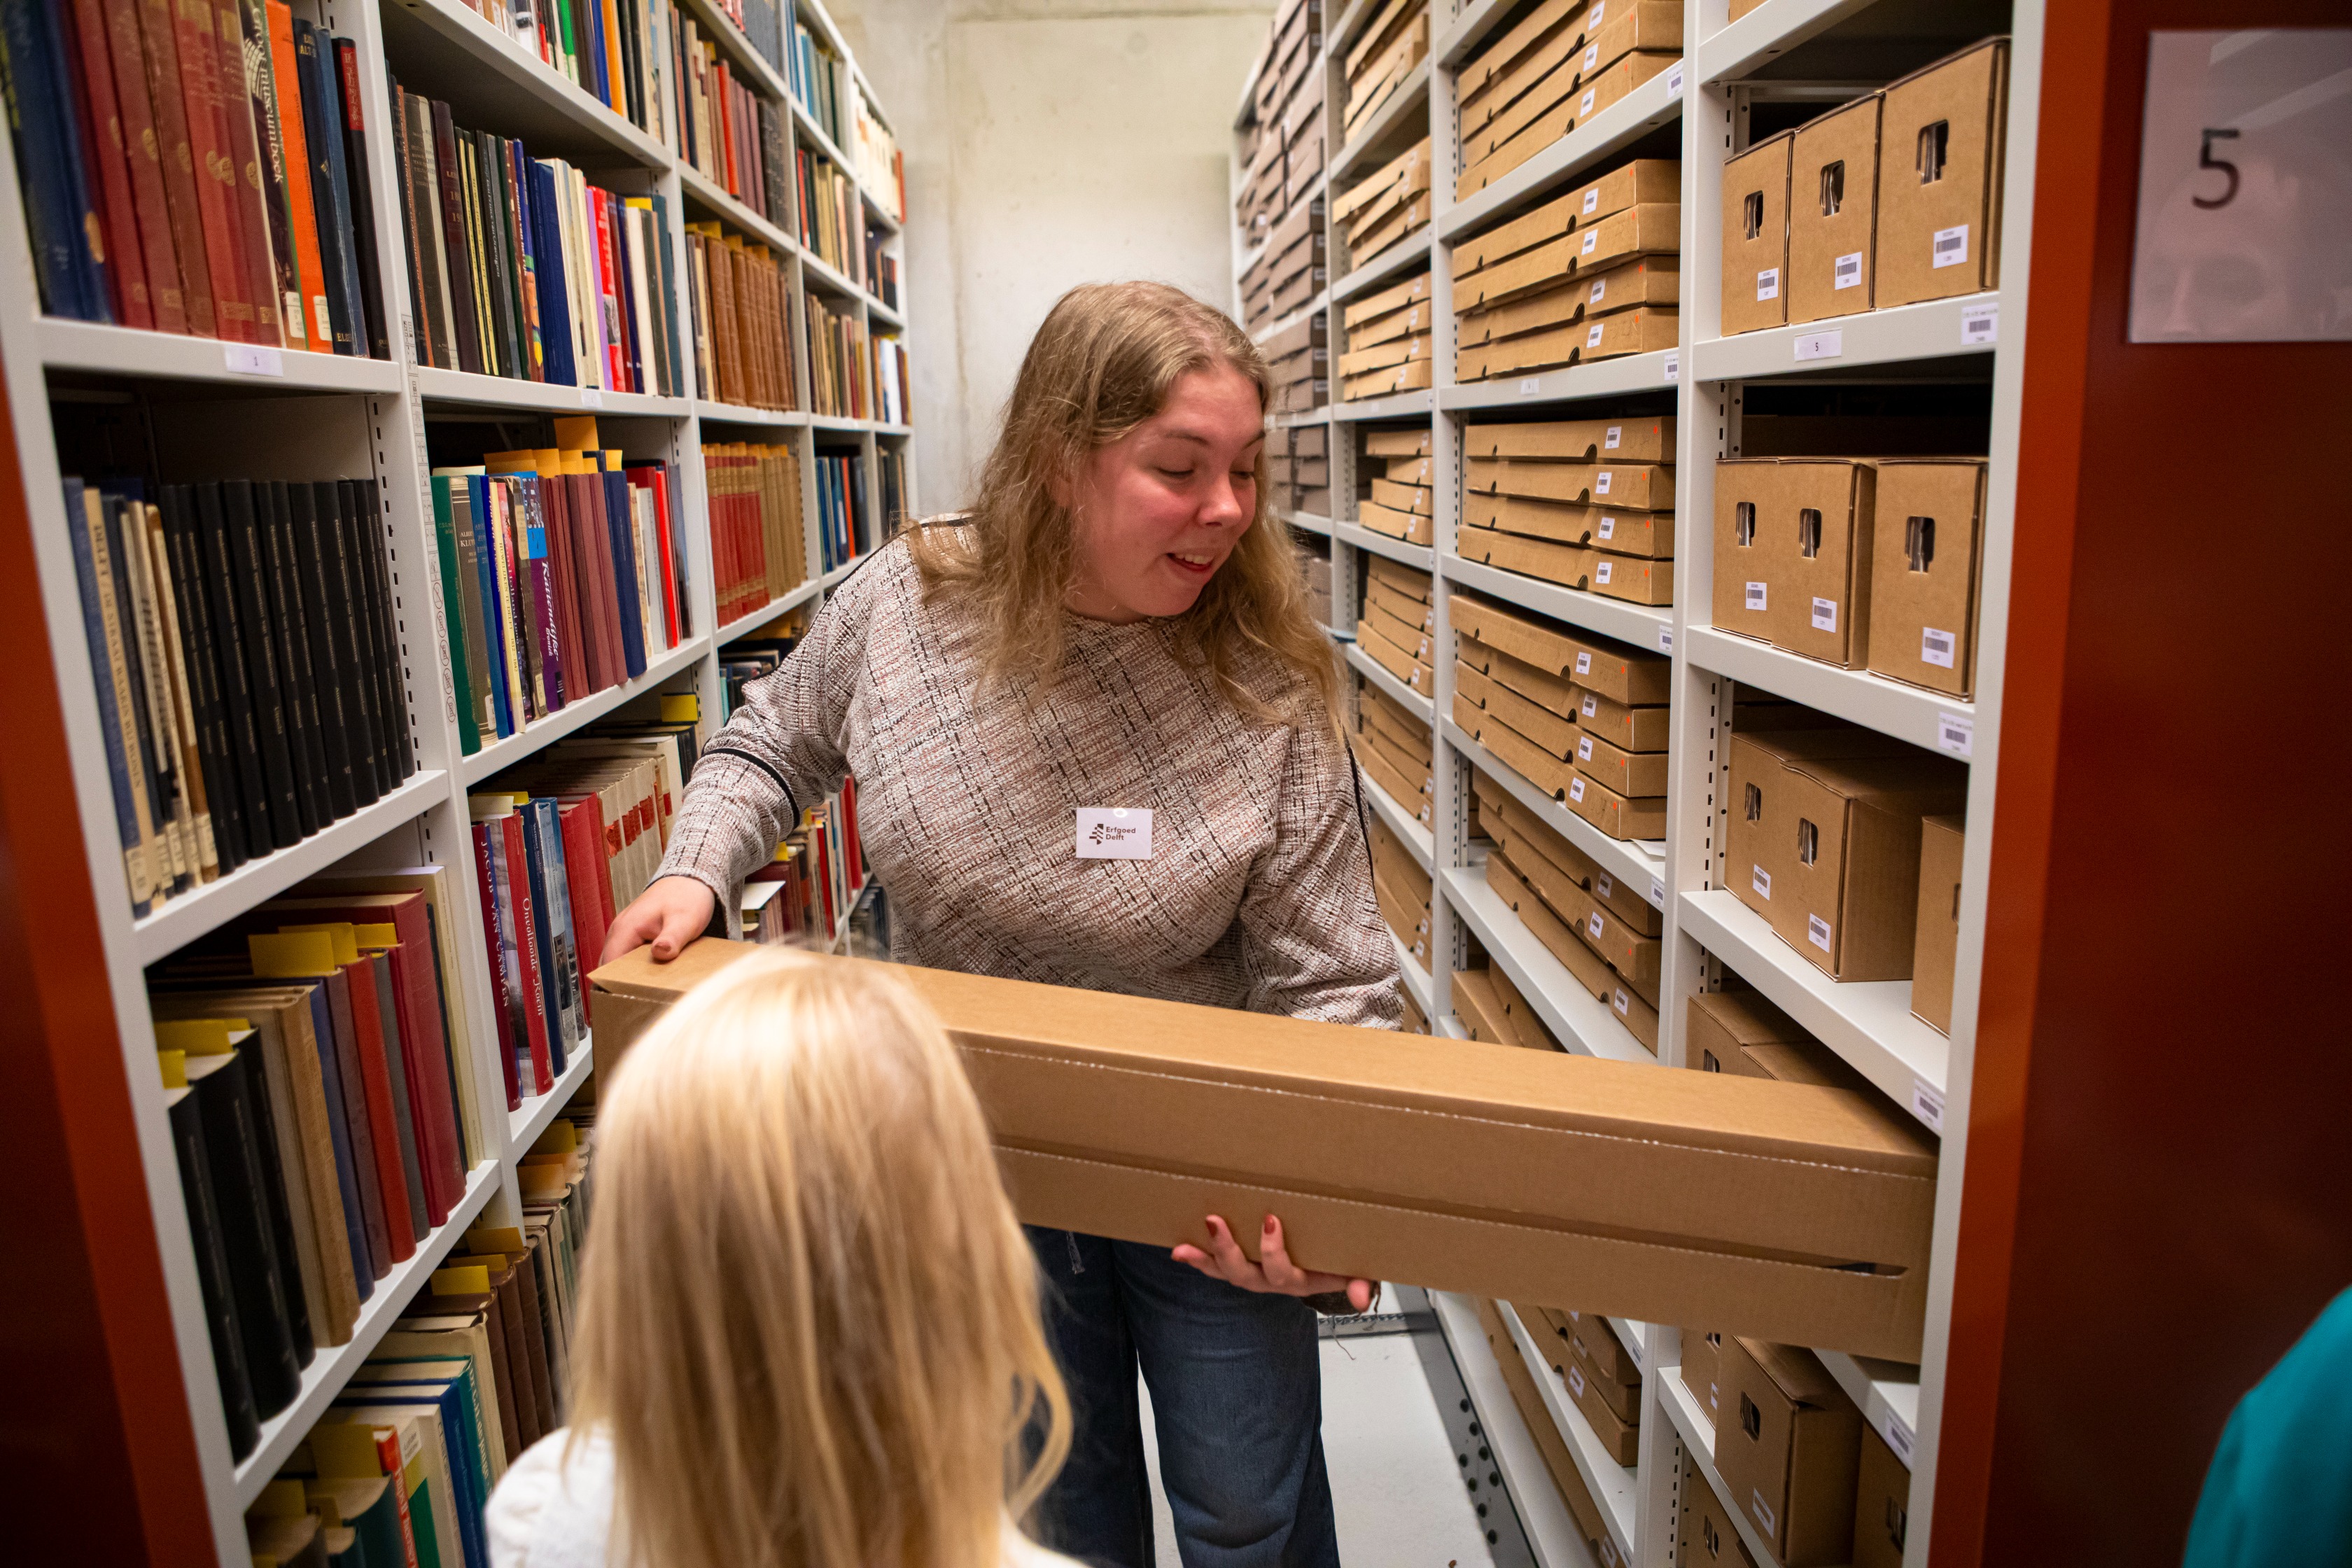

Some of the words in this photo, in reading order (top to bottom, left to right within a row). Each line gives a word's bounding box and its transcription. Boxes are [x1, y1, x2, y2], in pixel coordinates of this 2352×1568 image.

[261, 67, 281, 183] museumboek
[2192, 128, 2241, 209] 5
[498, 542, 509, 591] HUWELIJKEN
[507, 569, 517, 618] Holland
[481, 841, 493, 892] JACOB
[490, 902, 499, 933] VAN
[522, 897, 537, 972] Onvoltooide
[532, 974, 542, 1016] Roem
